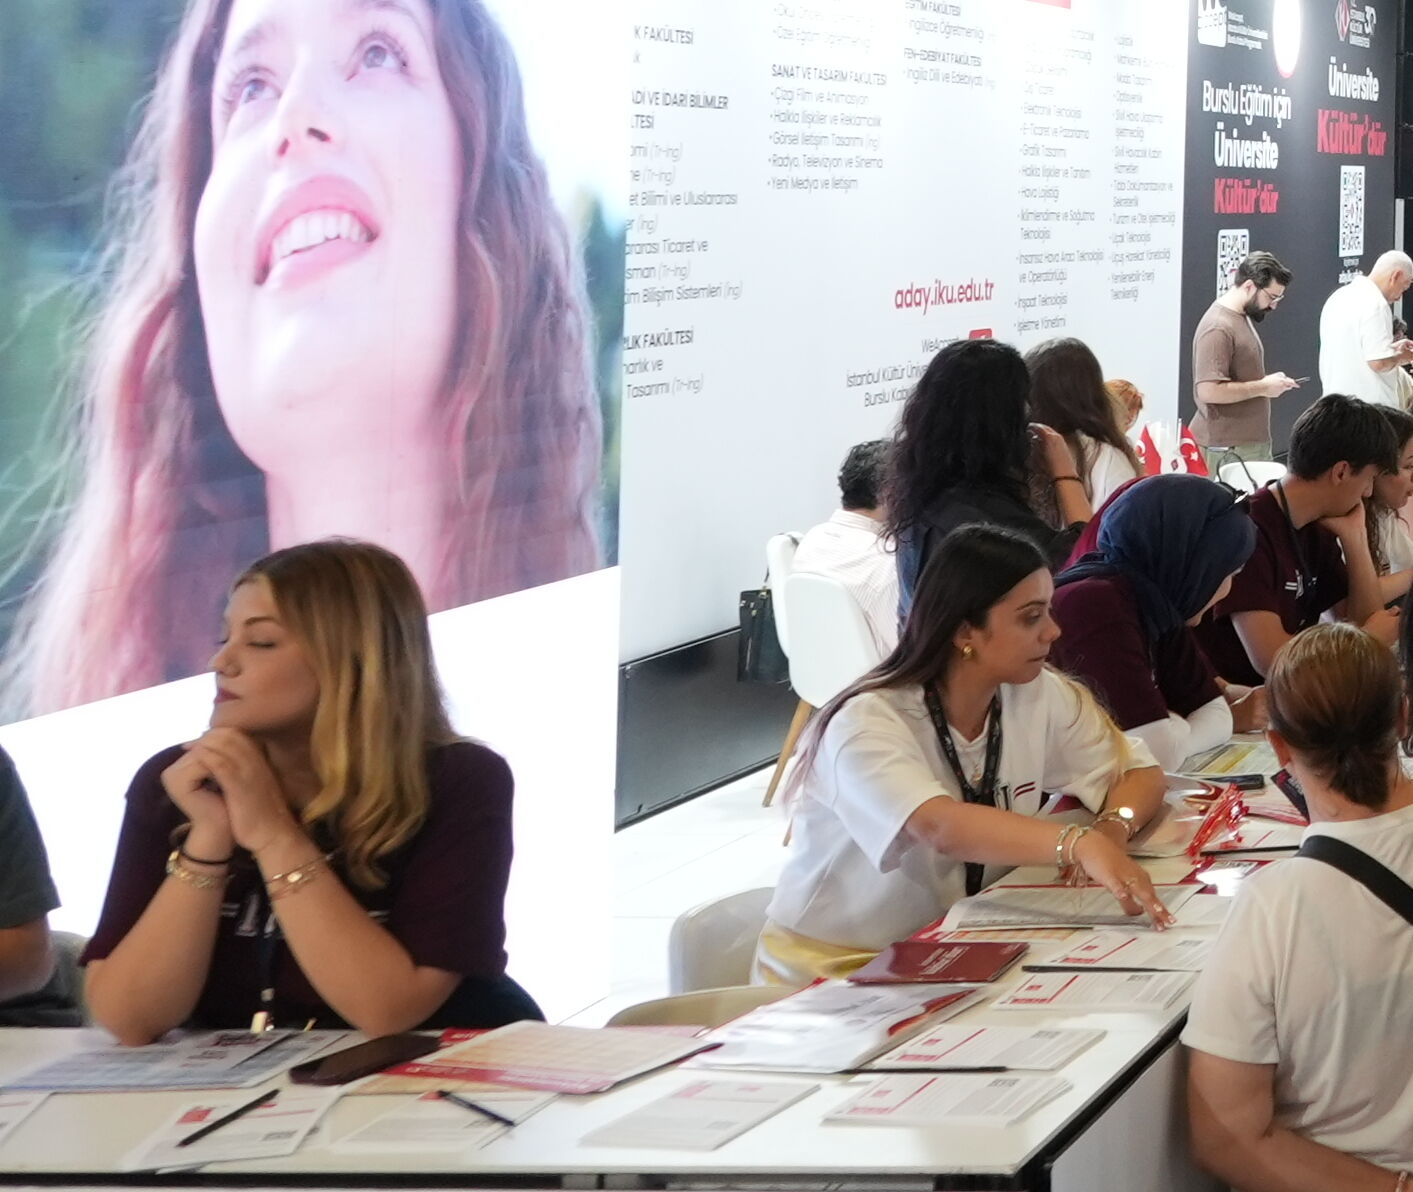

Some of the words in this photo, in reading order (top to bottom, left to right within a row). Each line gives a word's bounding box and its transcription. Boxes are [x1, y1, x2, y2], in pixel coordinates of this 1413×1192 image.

[1328, 56, 1380, 102] Üniversite
[1202, 80, 1239, 112] Burslu
[1239, 84, 1272, 125] Eğitim
[1273, 87, 1292, 128] için
[1214, 122, 1279, 170] Üniversite
[1317, 108, 1387, 156] Kültür'dür
[1214, 178, 1279, 214] Kültür'dür
[894, 277, 995, 316] aday.iku.edu.tr
